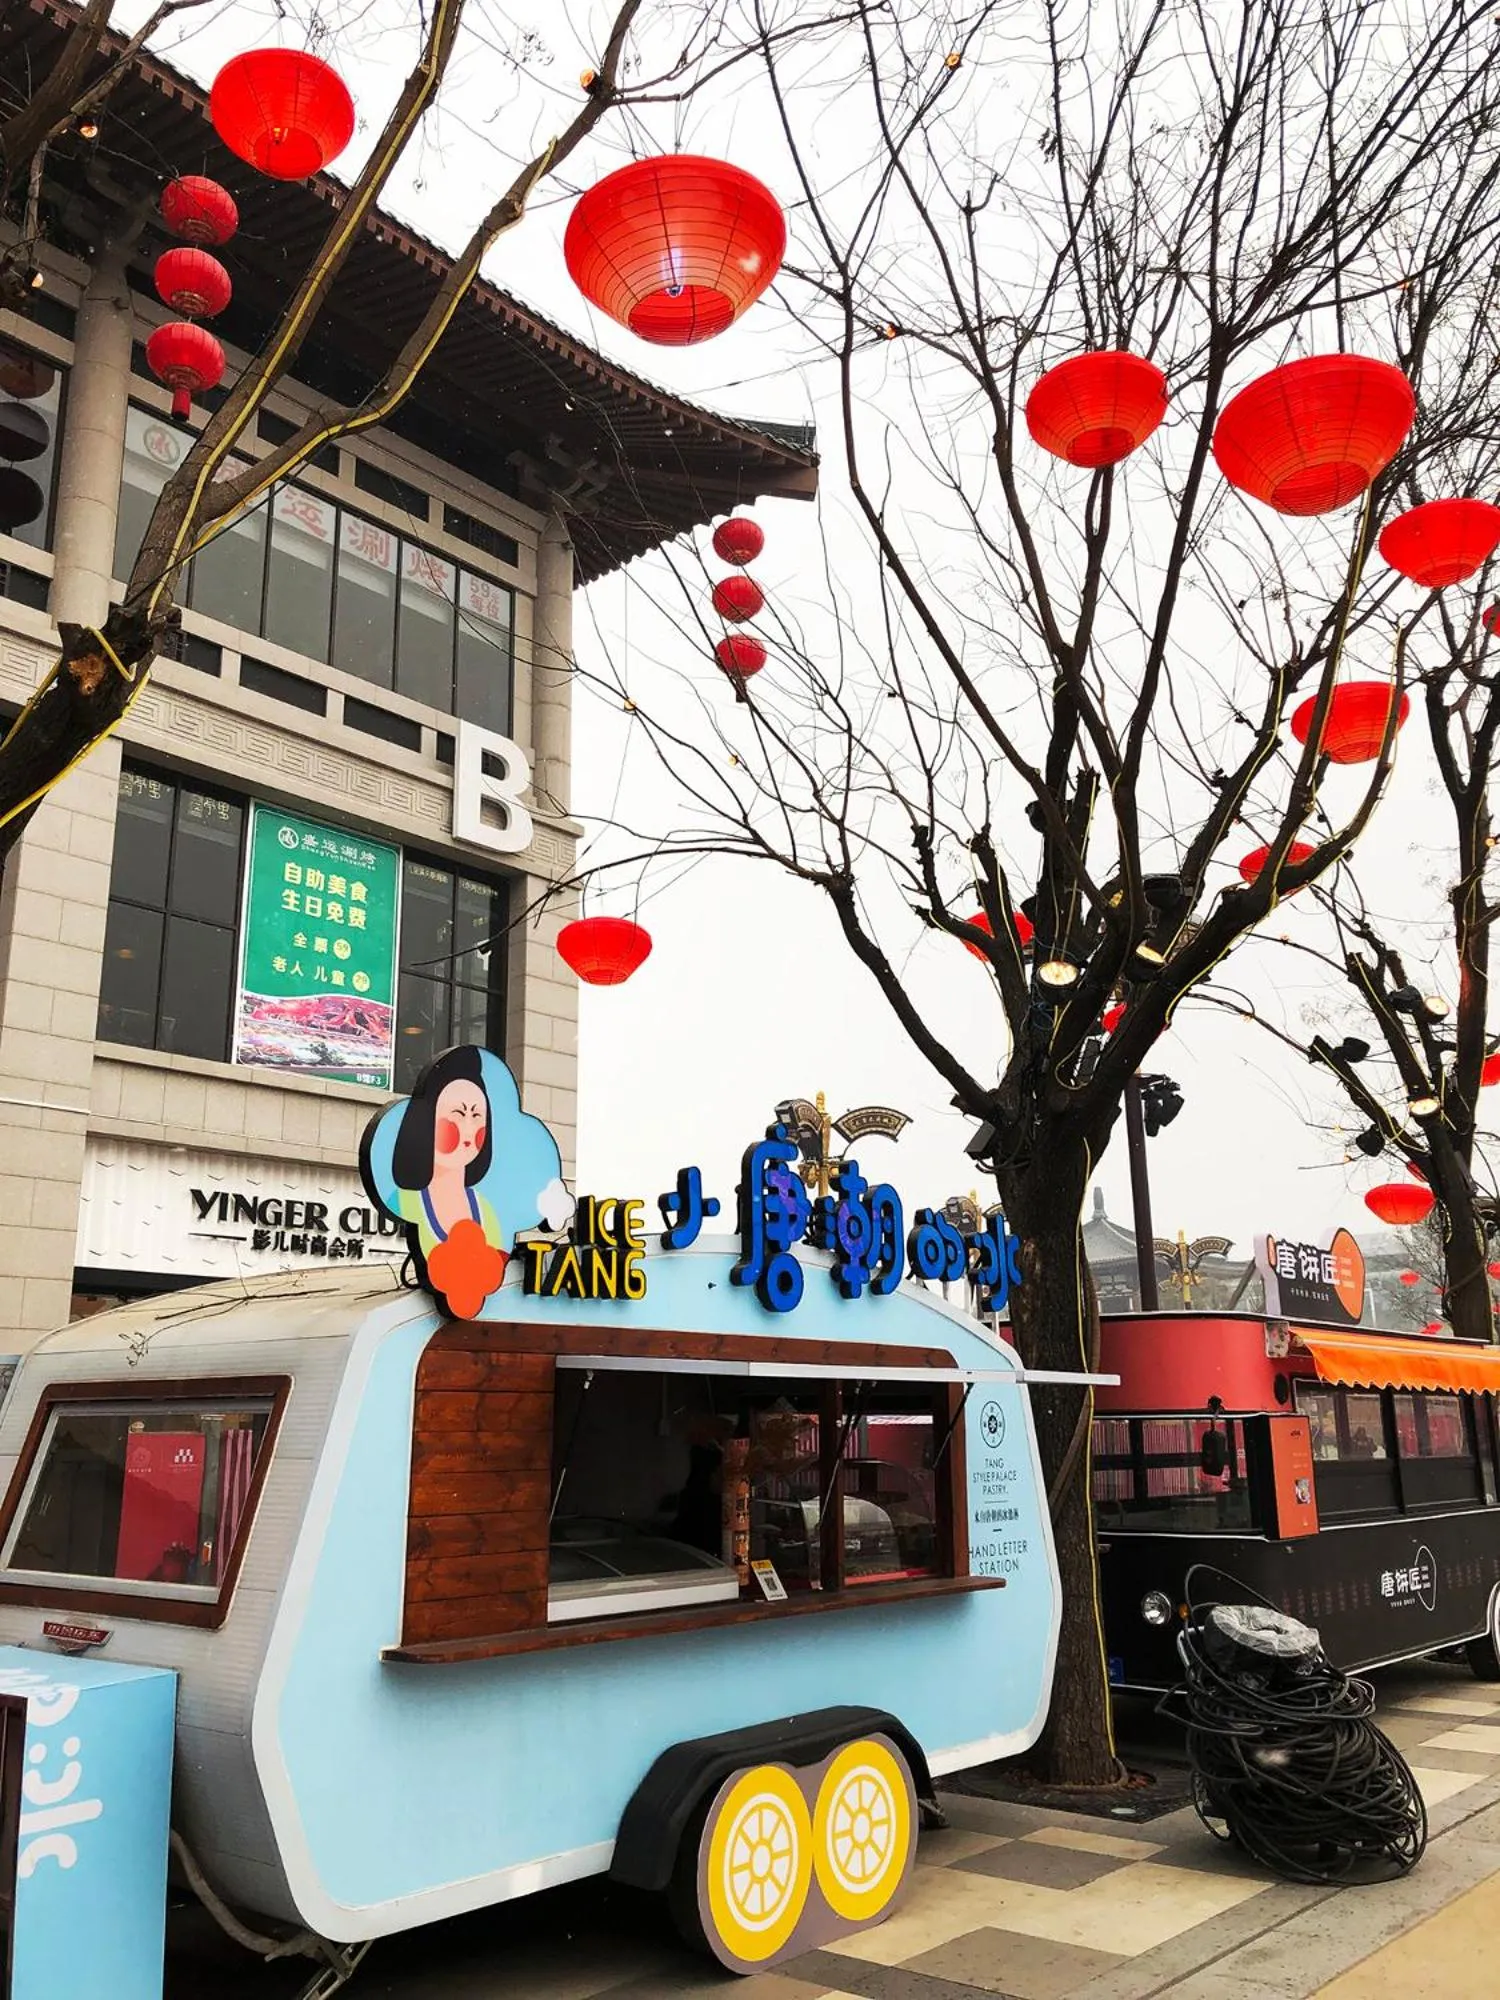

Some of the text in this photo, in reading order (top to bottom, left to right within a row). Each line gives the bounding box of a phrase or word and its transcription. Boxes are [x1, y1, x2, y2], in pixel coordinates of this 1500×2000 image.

[454, 719, 533, 853] B
[284, 861, 369, 904] 自助美食
[281, 888, 367, 931] 生日免费
[293, 931, 329, 954] 全票
[272, 955, 304, 977] 老人
[314, 965, 346, 987] 儿童
[190, 1189, 408, 1238] YINGER CLU
[580, 1195, 645, 1249] ICE
[251, 1229, 365, 1260] 影儿时尚会所
[1276, 1243, 1341, 1286] 唐饼匠
[525, 1241, 646, 1299] TANG
[985, 1458, 1005, 1468] TANG
[979, 1558, 1019, 1575] STATION
[1381, 1567, 1422, 1597] 唐饼匠
